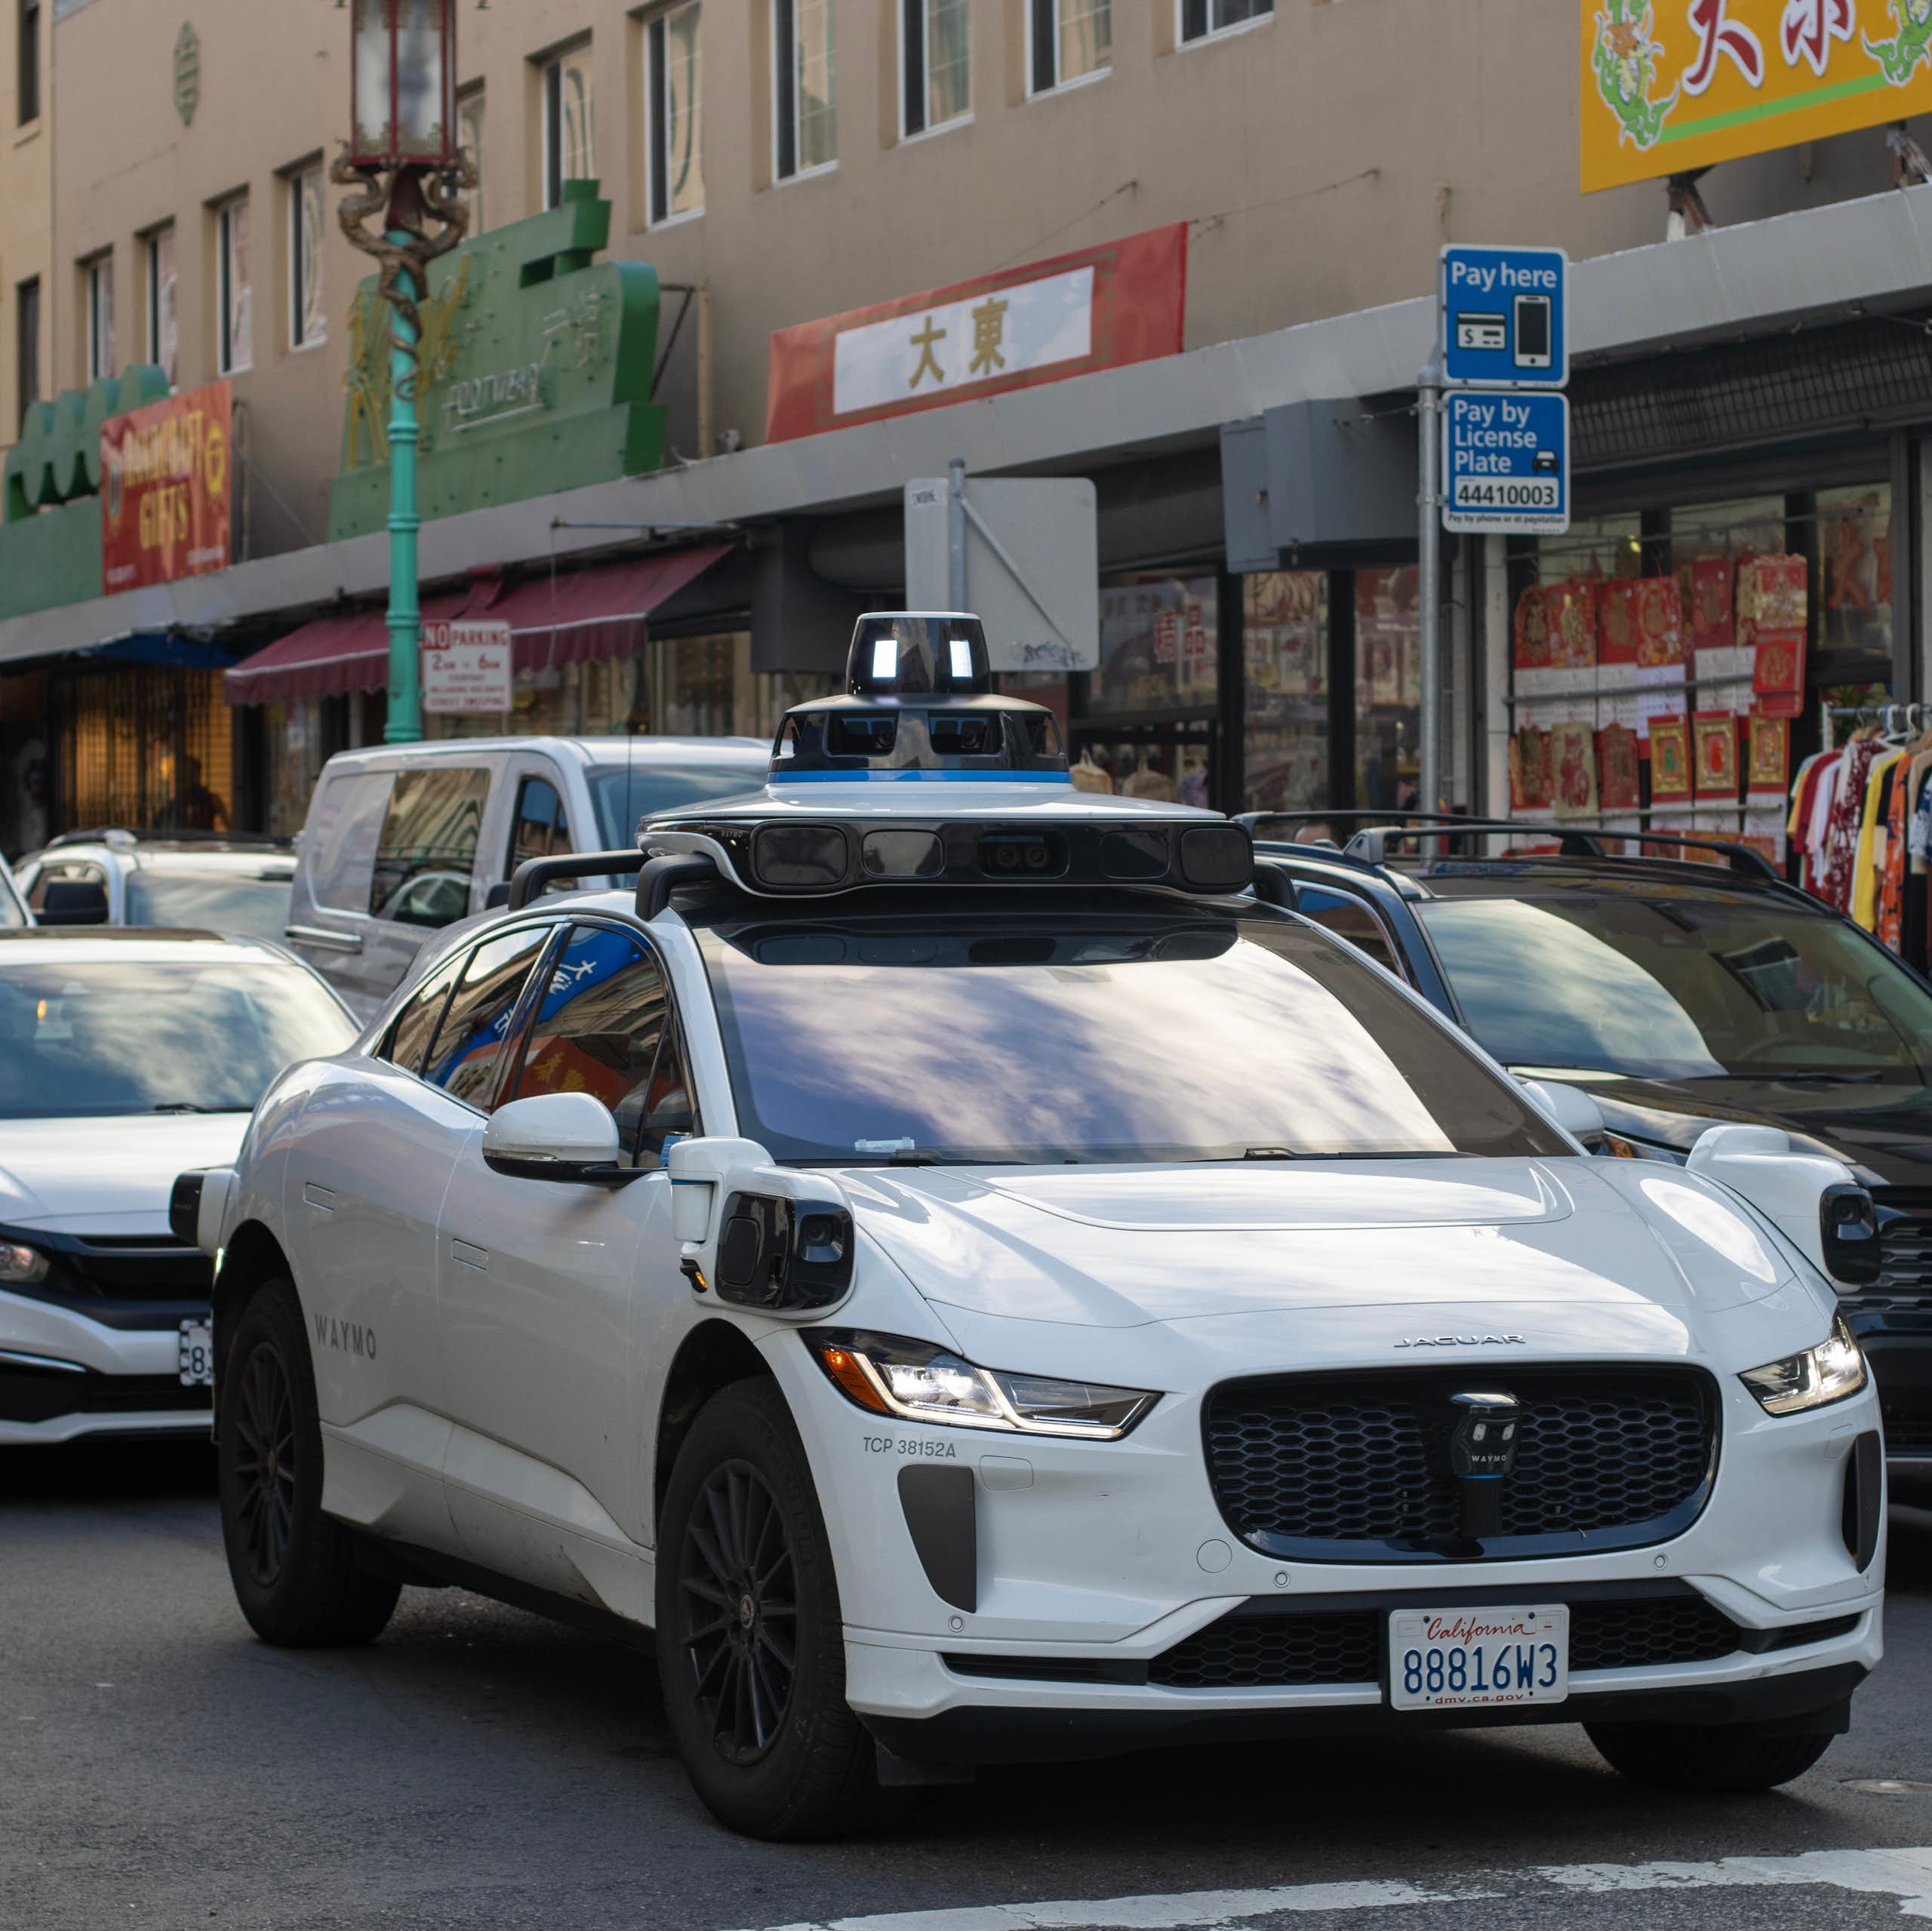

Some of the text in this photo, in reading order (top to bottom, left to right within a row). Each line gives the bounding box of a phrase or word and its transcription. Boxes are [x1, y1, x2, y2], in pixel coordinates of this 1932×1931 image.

[1451, 260, 1557, 293] Pay here
[909, 298, 1008, 389] 大東
[1454, 398, 1531, 429] Pay by
[1454, 423, 1537, 449] License
[1454, 448, 1512, 474] Plate
[1458, 484, 1555, 506] 44410003
[139, 483, 188, 551] GIFTS
[1448, 514, 1462, 523] Pay
[1464, 514, 1475, 523] by
[1476, 514, 1502, 524] phone
[423, 624, 509, 647] NO PARKING
[314, 1313, 377, 1361] WAYMO
[1394, 1335, 1526, 1348] JAGUAR
[863, 1437, 957, 1459] TCP 38152A
[1471, 1454, 1508, 1462] WAYMO
[1426, 1617, 1537, 1646] California
[1404, 1643, 1557, 1694] 88816W3
[1435, 1693, 1524, 1705] dmv.ca.gov
